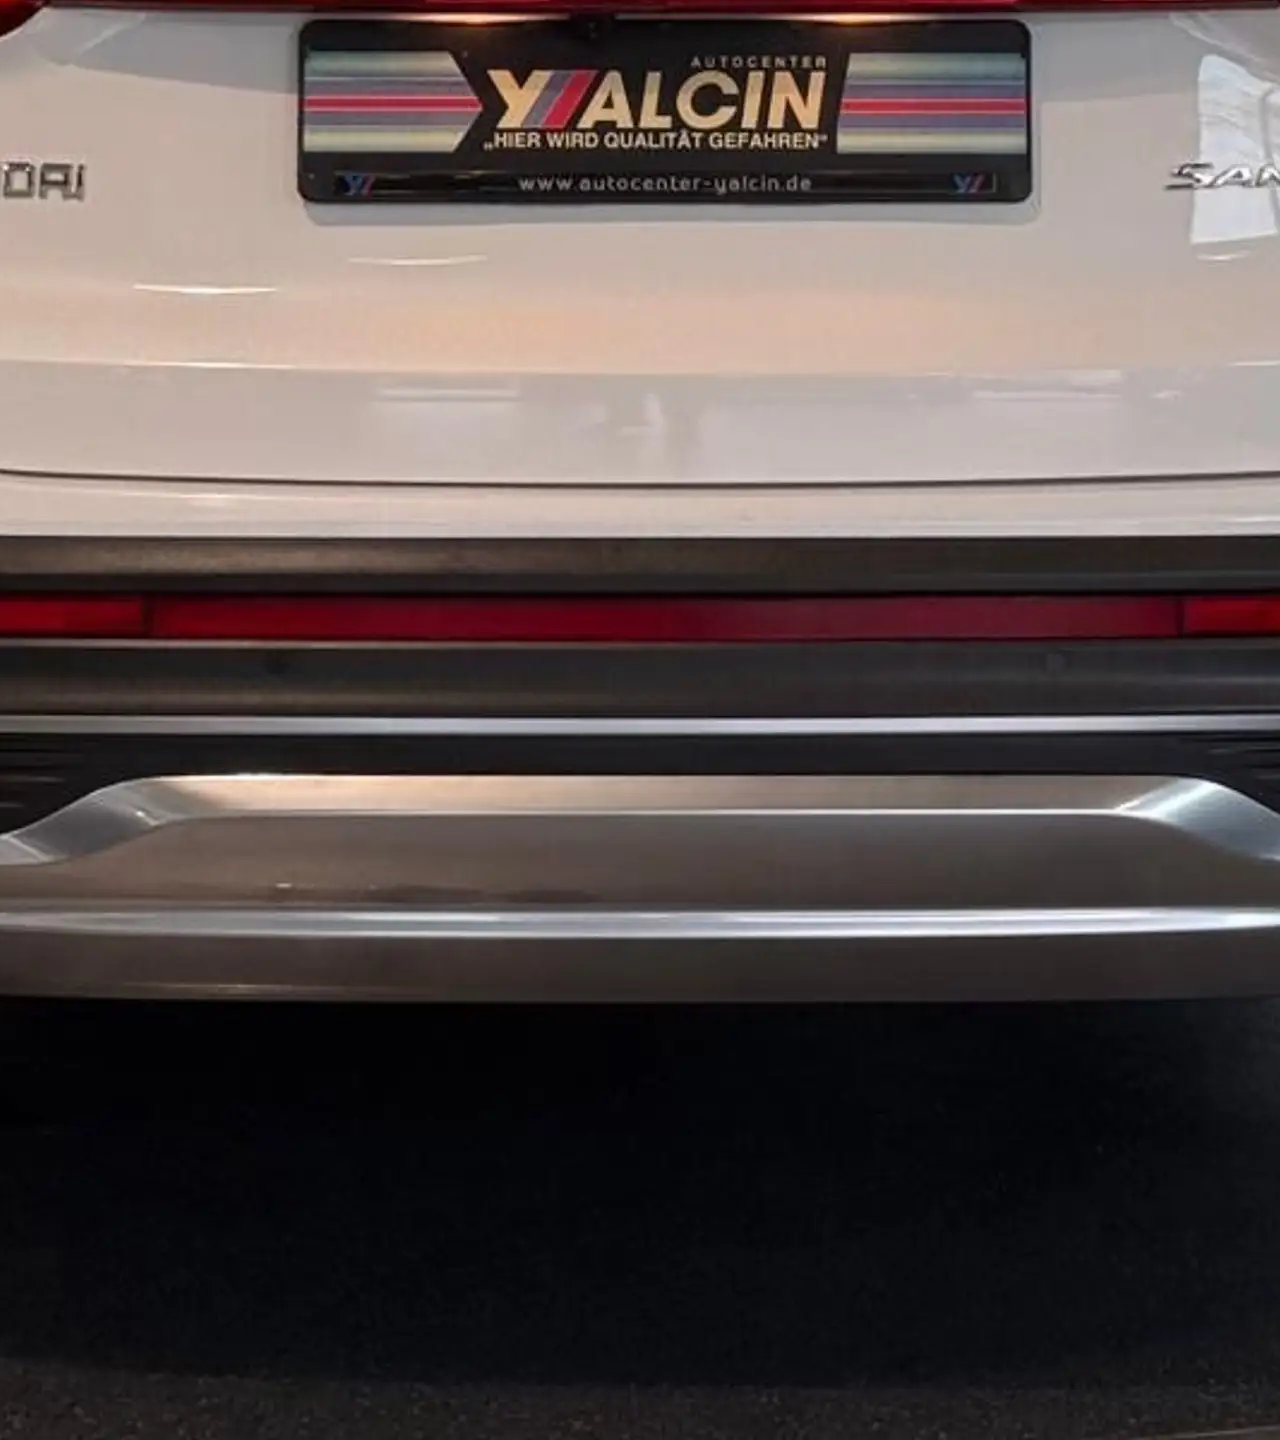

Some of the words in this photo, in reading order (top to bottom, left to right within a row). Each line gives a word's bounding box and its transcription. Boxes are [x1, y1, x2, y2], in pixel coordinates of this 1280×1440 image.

[689, 55, 827, 69] AUTOCENTER
[545, 131, 599, 149] WIRD
[603, 129, 704, 150] QUALITÄT
[519, 174, 812, 195] www.autocenter-yalcin.de
